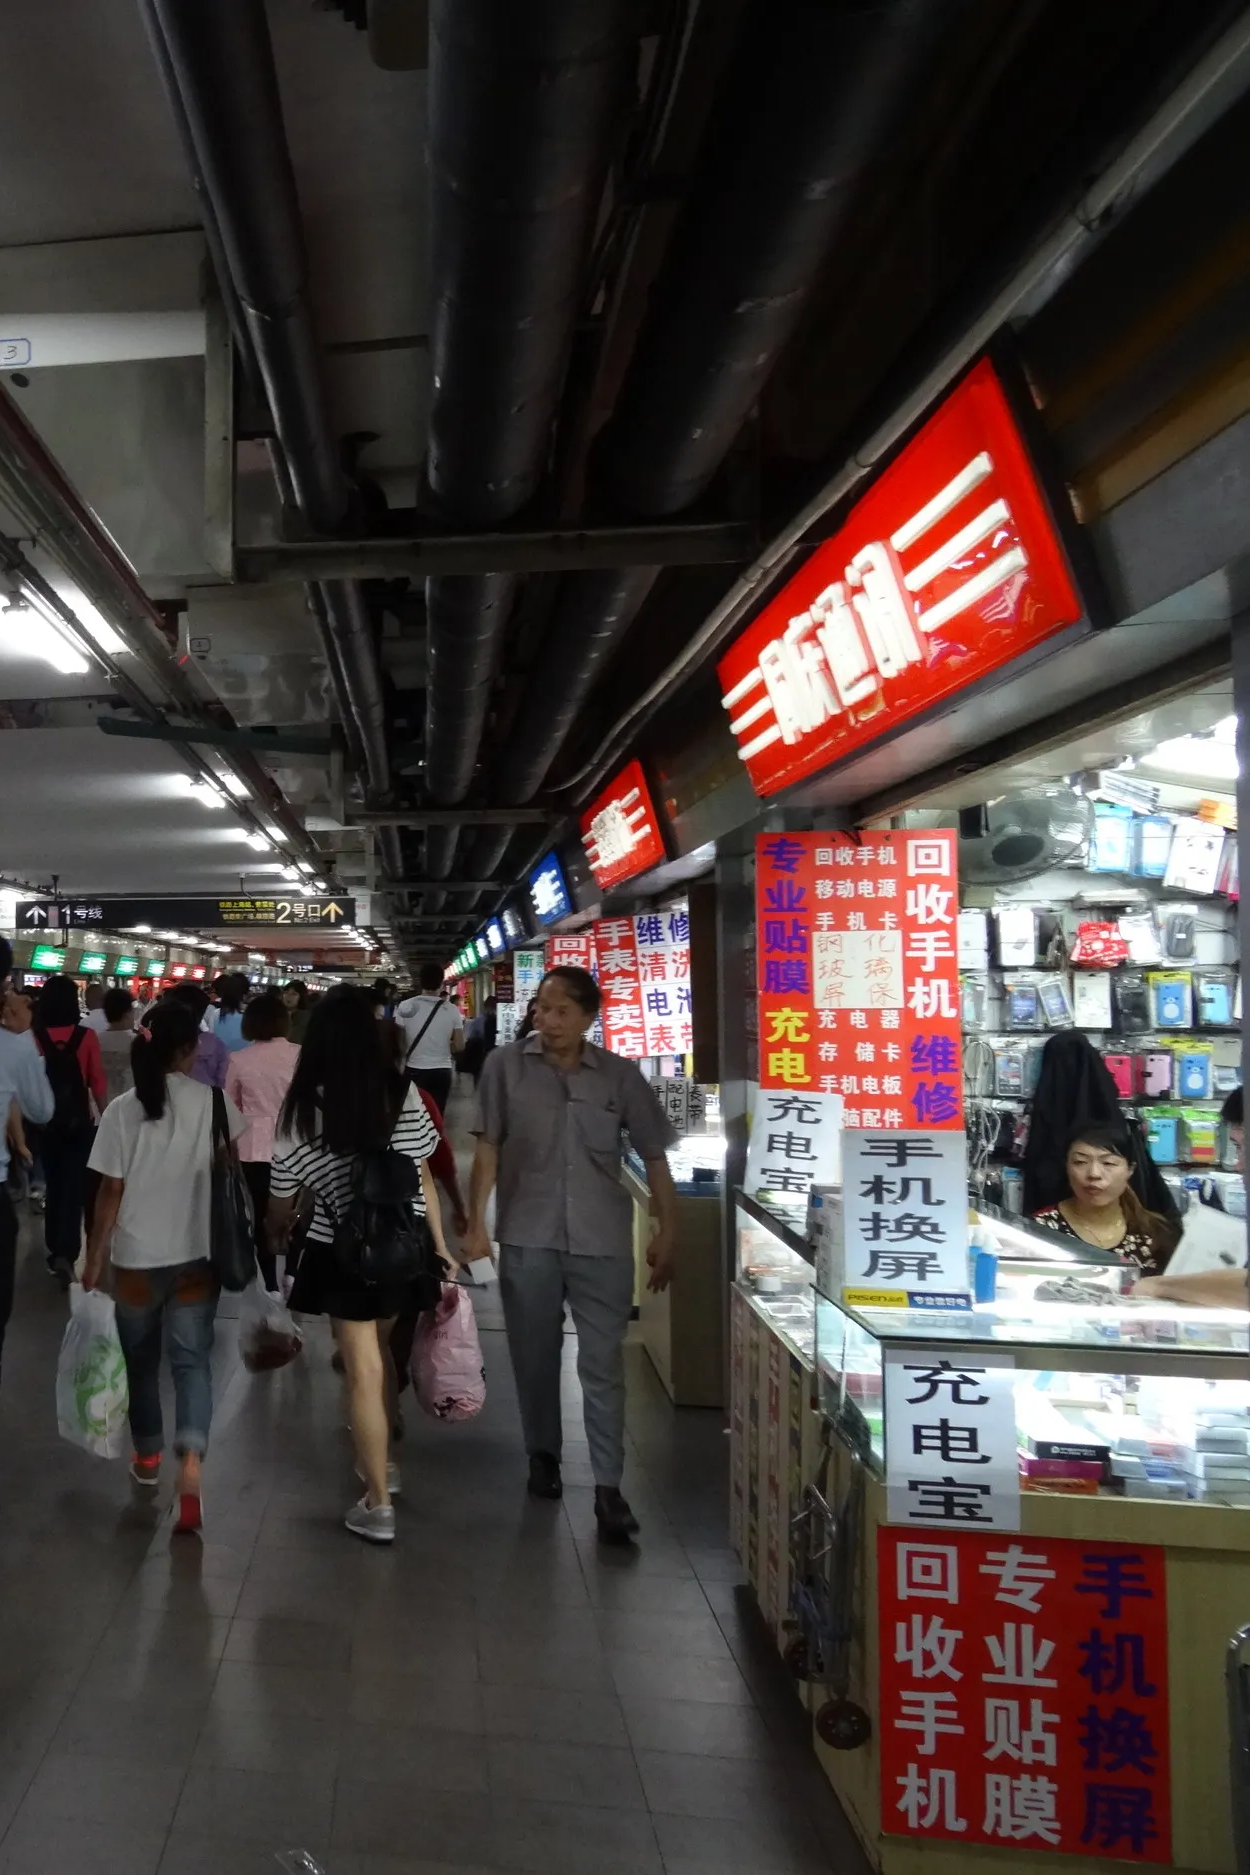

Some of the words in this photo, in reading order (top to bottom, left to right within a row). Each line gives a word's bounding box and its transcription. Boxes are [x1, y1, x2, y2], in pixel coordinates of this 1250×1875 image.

[3, 345, 17, 360] 3
[815, 846, 897, 866] 回收手机
[815, 879, 897, 899] 移动电源
[636, 911, 688, 945] 维修
[762, 838, 810, 995] 专业贴膜
[815, 911, 898, 931] 手机卡
[906, 839, 958, 1019] 回收手机
[597, 920, 645, 1057] 手表专卖店
[818, 1010, 899, 1029] 充电器
[765, 1008, 812, 1090] 充电
[818, 1042, 901, 1062] 存储卡
[819, 1075, 902, 1094] 手机电板
[910, 1034, 958, 1123] 维修
[760, 1096, 822, 1192] 充电宝
[843, 1108, 903, 1128] 脑配件
[860, 1138, 947, 1281] 手机换屏
[903, 1361, 993, 1523] 充电宝
[894, 1542, 969, 1833] 回收手机
[979, 1545, 1061, 1845] 专业贴膜
[1074, 1554, 1159, 1854] 手机换屏
